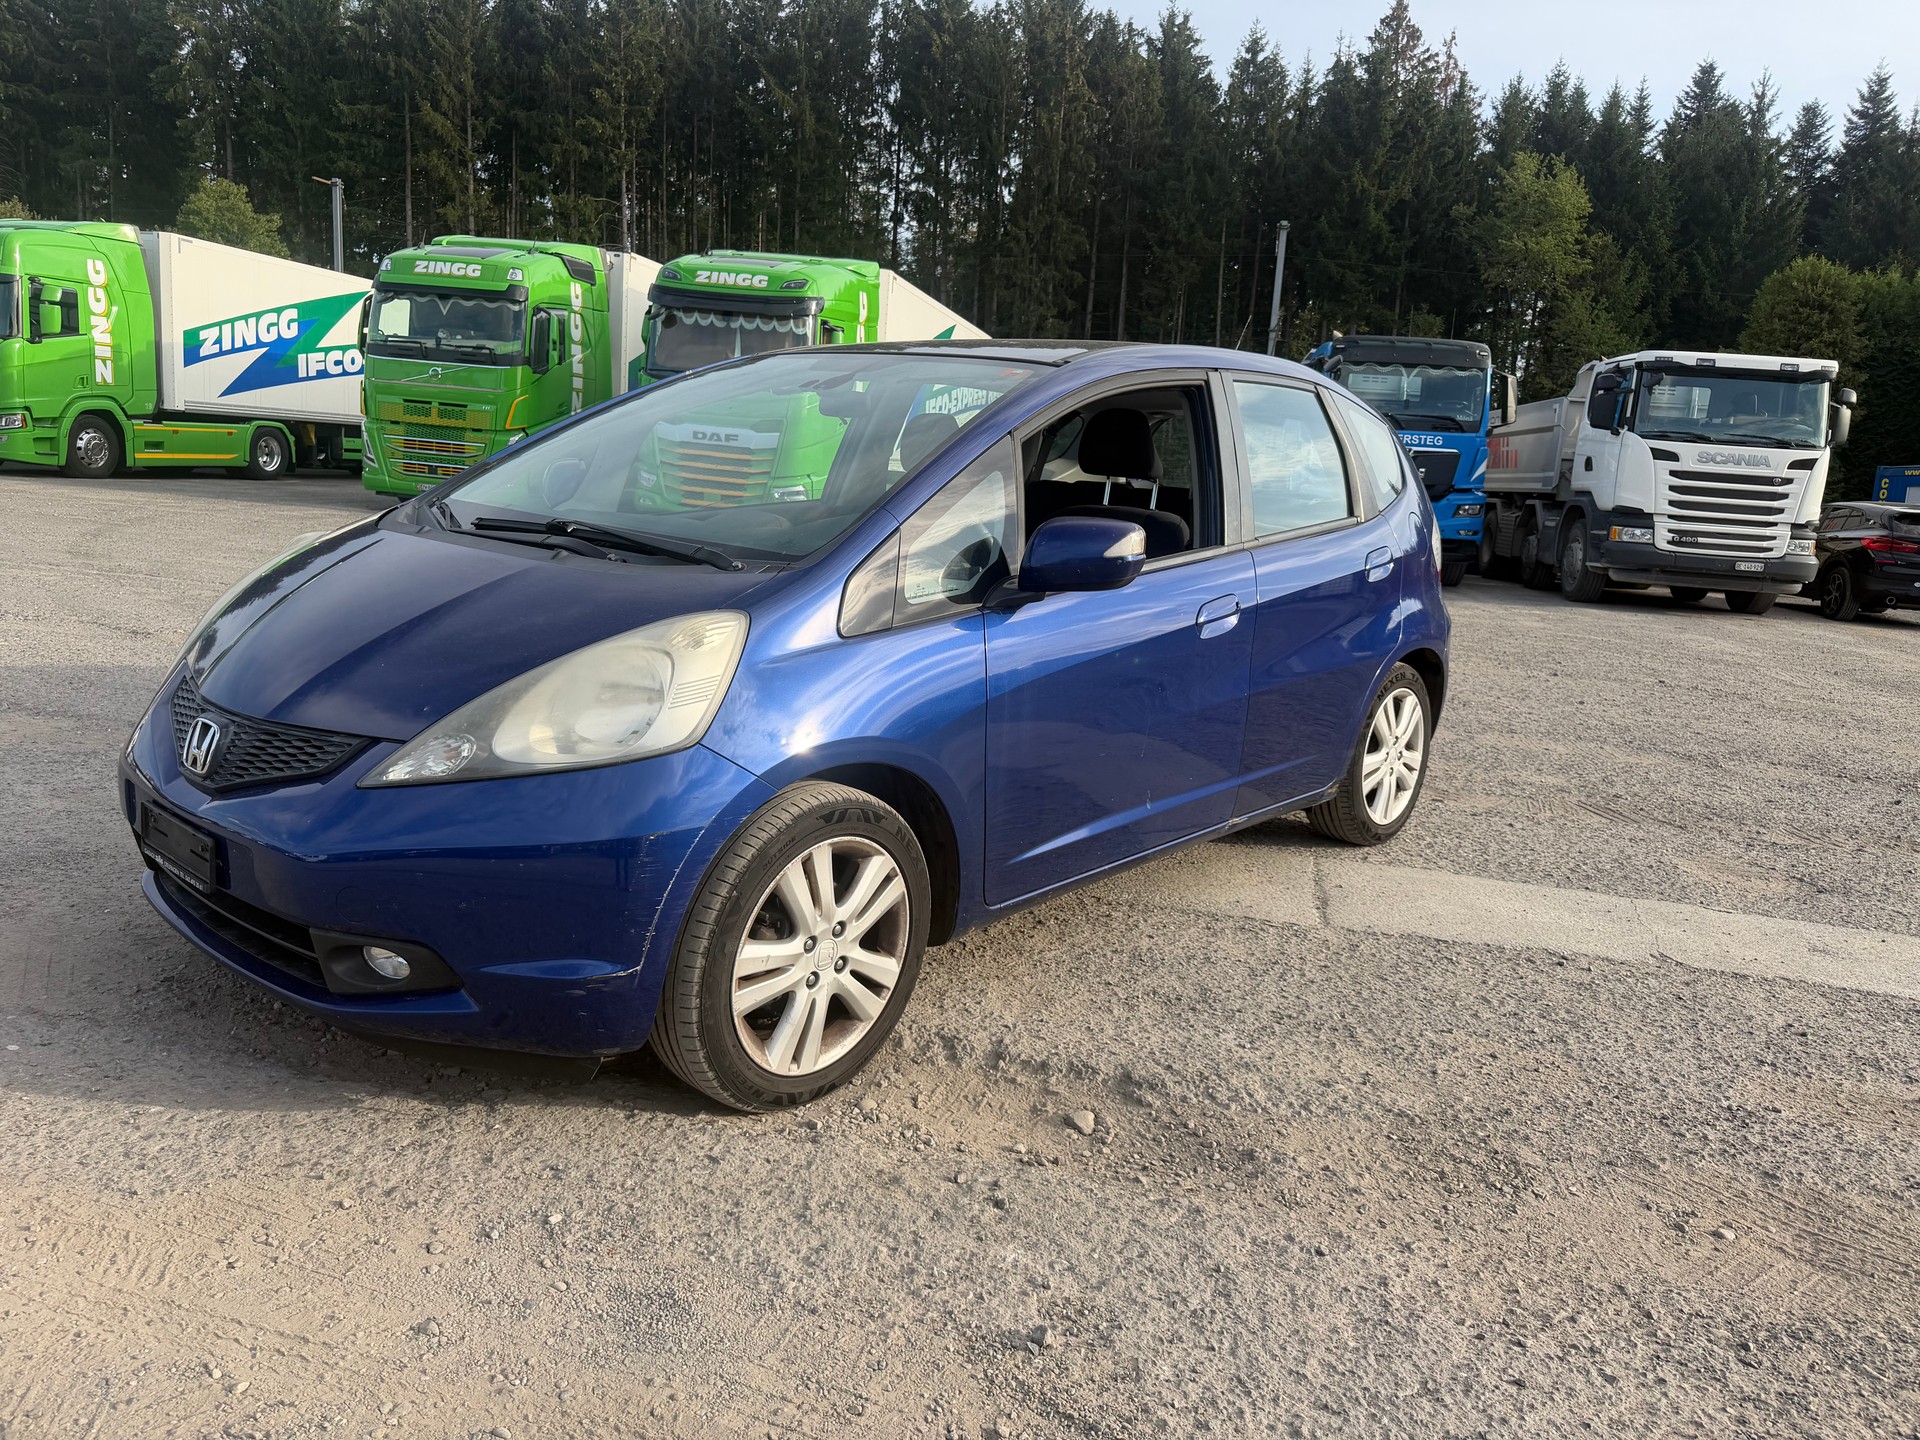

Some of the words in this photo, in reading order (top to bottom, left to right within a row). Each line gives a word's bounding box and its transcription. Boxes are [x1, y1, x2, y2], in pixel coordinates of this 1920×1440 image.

[414, 260, 482, 278] ZINGG
[695, 270, 769, 288] ZINGG
[87, 258, 114, 385] ZINGG
[199, 308, 298, 357] ZINGG
[570, 281, 584, 415] ZINGG
[298, 349, 364, 378] IFCO
[692, 430, 739, 443] DAF
[1696, 450, 1772, 468] SCANIA
[1376, 671, 1407, 702] NEXEN
[761, 834, 798, 872] OUTSIDE
